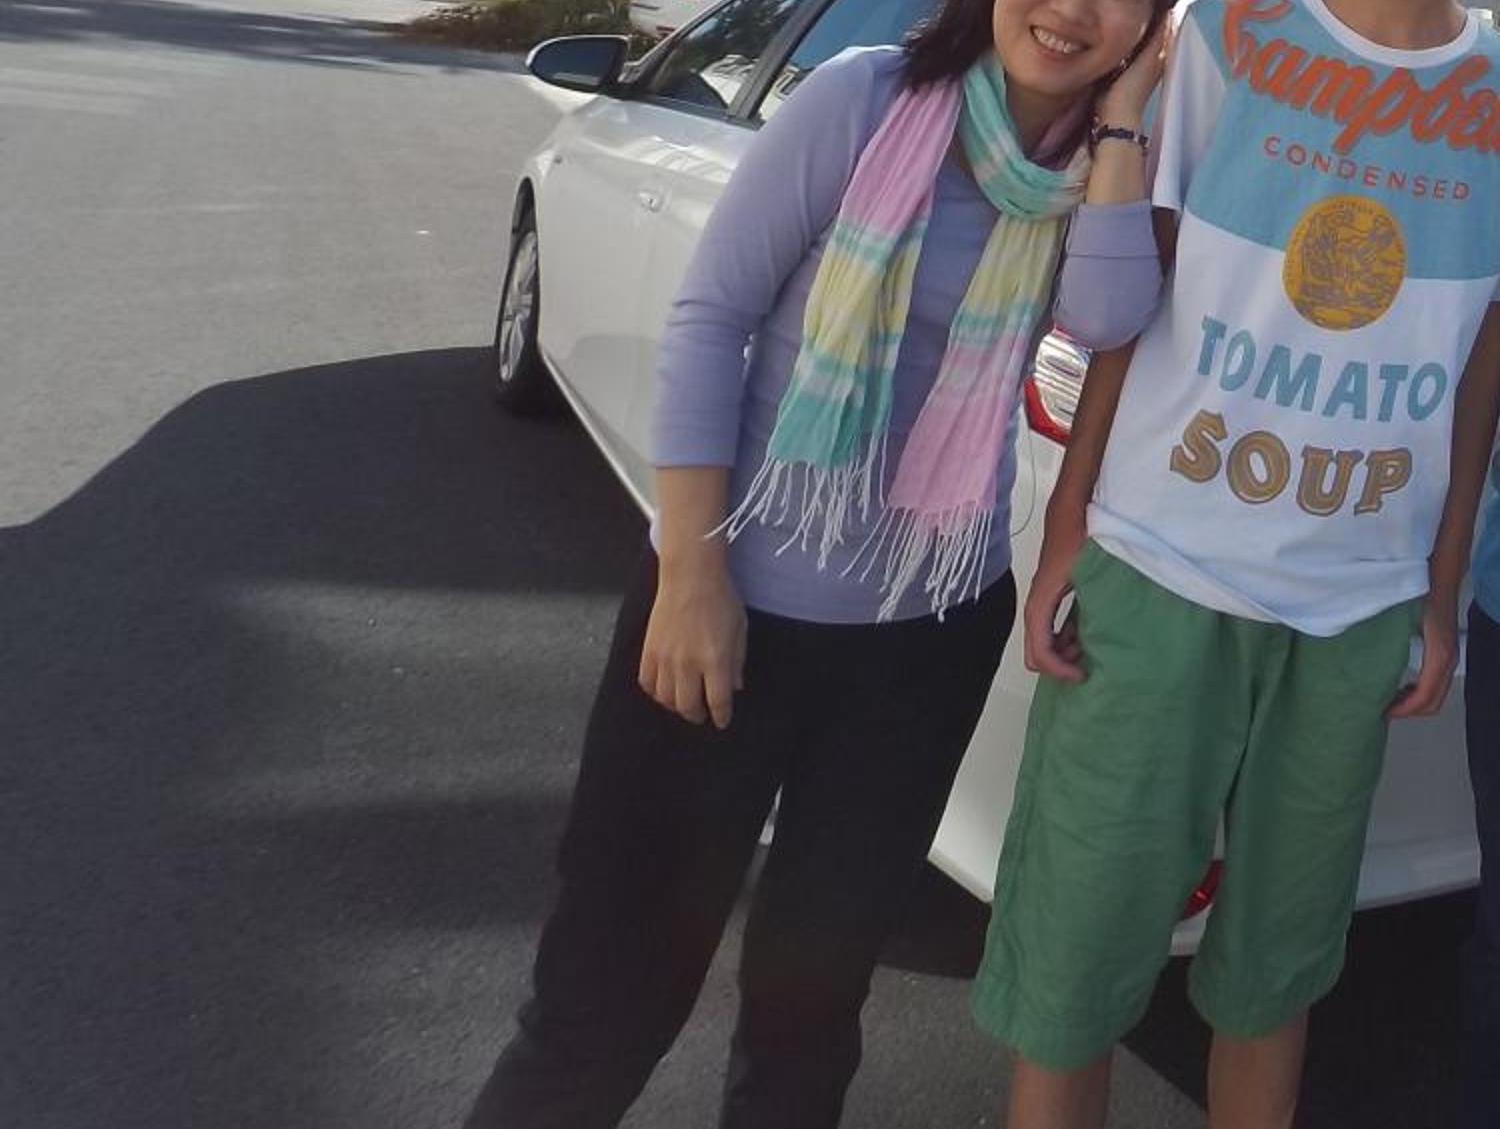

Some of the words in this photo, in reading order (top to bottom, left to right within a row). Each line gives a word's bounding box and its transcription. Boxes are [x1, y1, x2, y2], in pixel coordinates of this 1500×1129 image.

[1264, 136, 1470, 200] CONDENSED
[1200, 317, 1448, 423] TOMATO
[1169, 408, 1412, 516] SOUP
